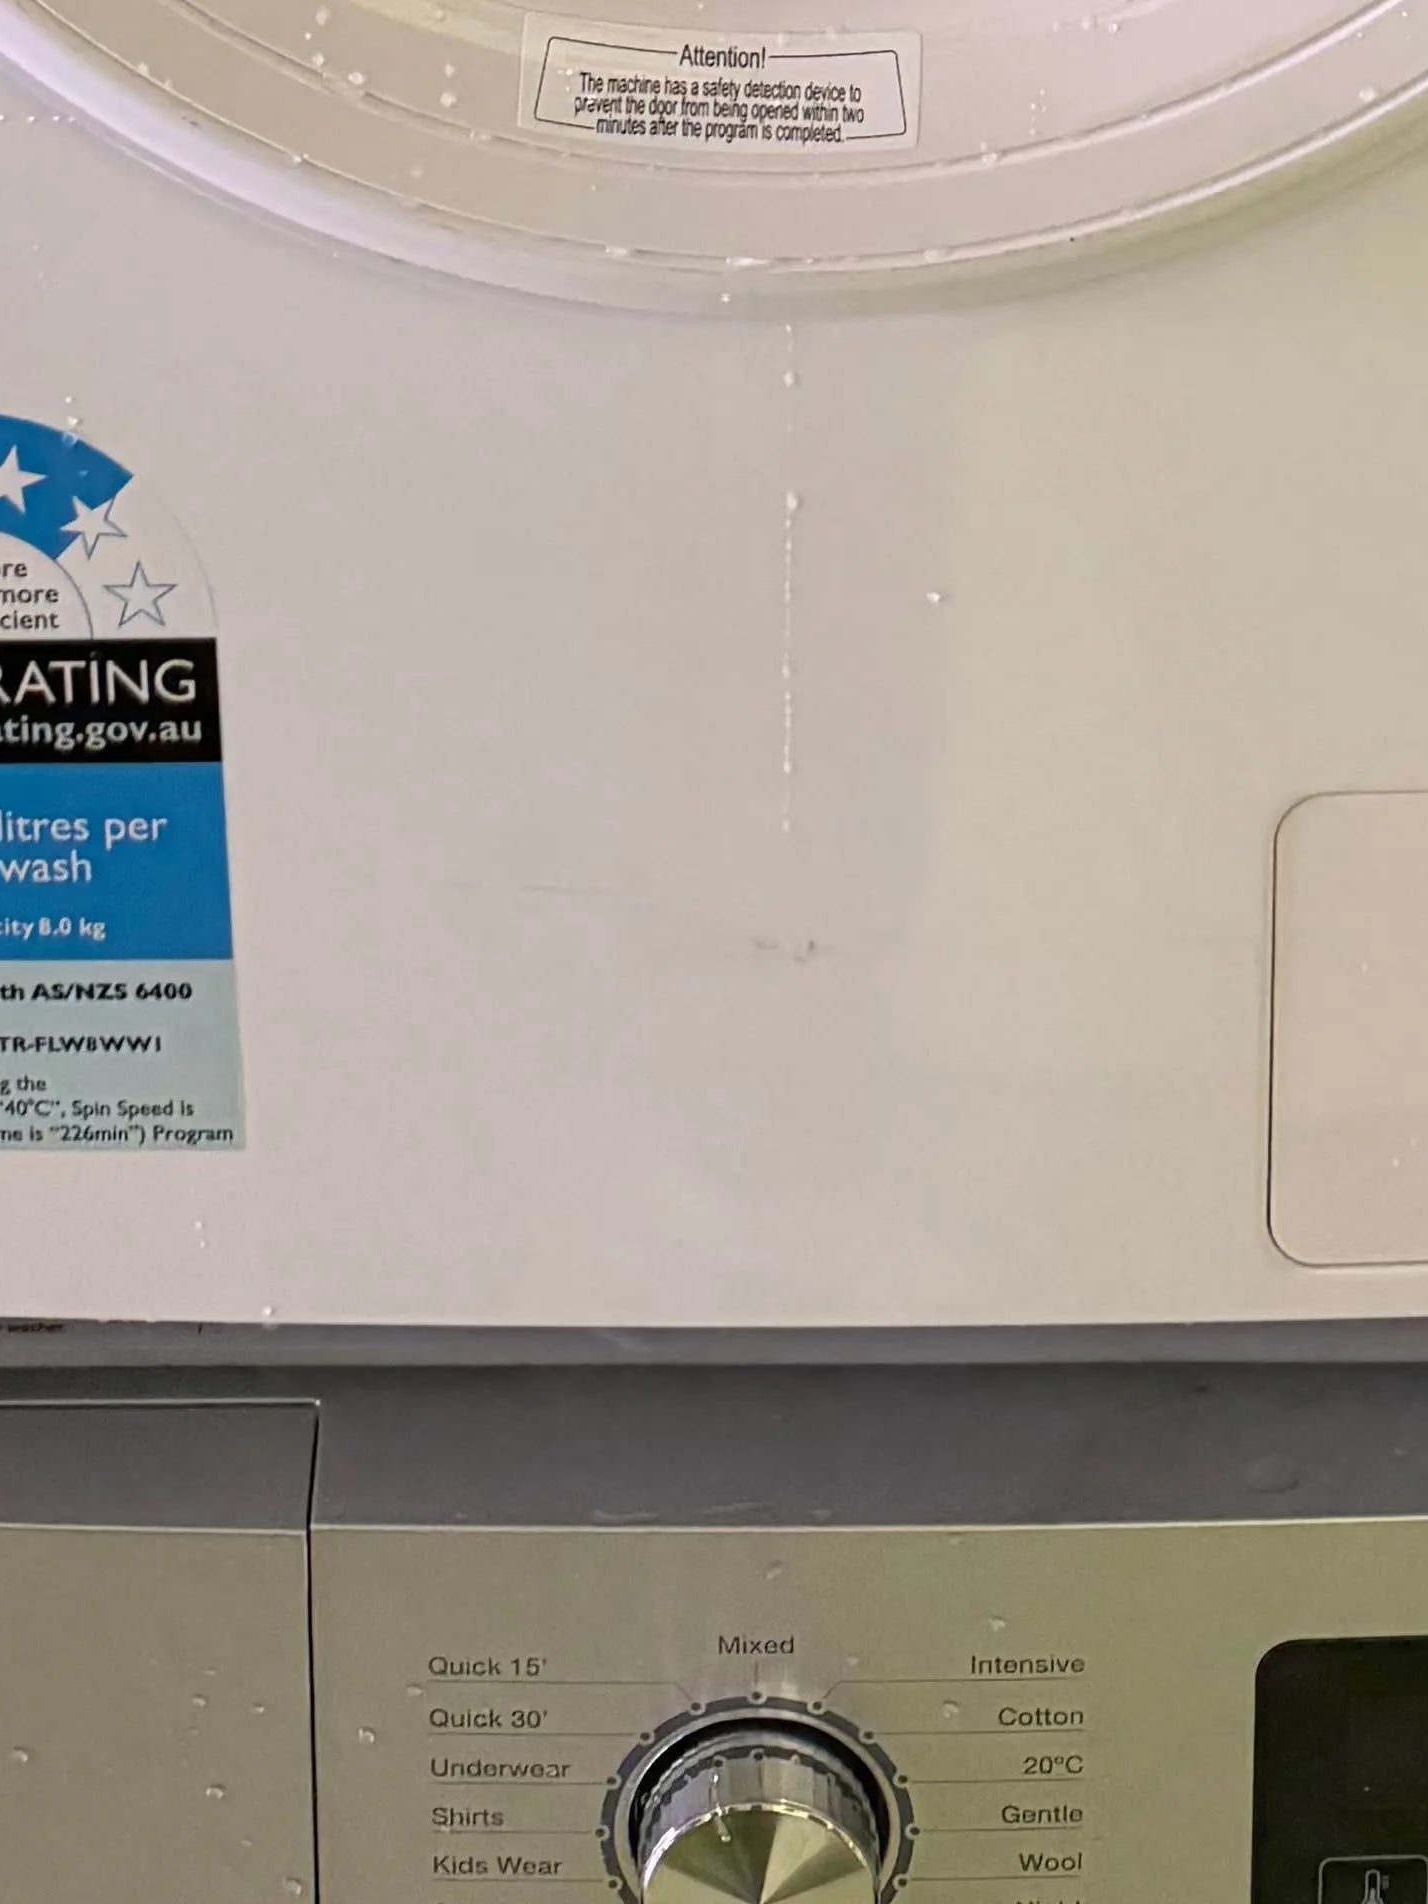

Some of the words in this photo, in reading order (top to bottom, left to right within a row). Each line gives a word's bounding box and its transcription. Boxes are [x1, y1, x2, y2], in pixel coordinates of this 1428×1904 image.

[680, 44, 766, 68] Attention!
[580, 72, 603, 93] The
[608, 75, 661, 93] machine
[665, 76, 687, 95] has
[691, 82, 699, 96] a
[702, 77, 740, 101] safety
[744, 80, 801, 99] detection
[805, 81, 846, 102] device
[849, 84, 862, 102] to
[574, 96, 621, 117] prevent
[626, 96, 645, 115] the
[649, 96, 678, 116] door
[681, 97, 710, 116] from
[713, 100, 748, 122] being
[751, 102, 799, 123] opened
[802, 104, 838, 122] within
[843, 106, 864, 123] two
[596, 116, 646, 135] minutes
[649, 118, 678, 136] after
[682, 118, 702, 137] the
[705, 122, 758, 143] program
[762, 123, 772, 140] is
[776, 123, 844, 144] completed.
[104, 816, 168, 849] per
[38, 919, 72, 936] 8.0
[78, 918, 106, 941] kg
[31, 982, 128, 1000] AS/NZS
[135, 983, 192, 1000] 6400
[17, 1075, 47, 1092] the
[71, 1100, 111, 1120] Spin
[117, 1100, 173, 1121] Speed
[181, 1100, 194, 1116] is
[29, 1126, 43, 1141] is
[153, 1125, 234, 1145] Program
[719, 1635, 795, 1655] Mixed
[428, 1656, 500, 1678] Quick
[511, 1656, 547, 1676] 15'
[972, 1655, 1085, 1675] Intensive
[429, 1708, 501, 1730] Quick
[512, 1708, 548, 1729] 30'
[998, 1707, 1084, 1727] Cotton
[431, 1758, 570, 1779] Underwear
[1023, 1754, 1084, 1775] 20°C
[432, 1806, 504, 1827] Shirts
[1001, 1804, 1084, 1825] Gentle
[433, 1856, 488, 1874] Kids
[497, 1856, 563, 1874] Wear
[1018, 1852, 1082, 1871] Wool
